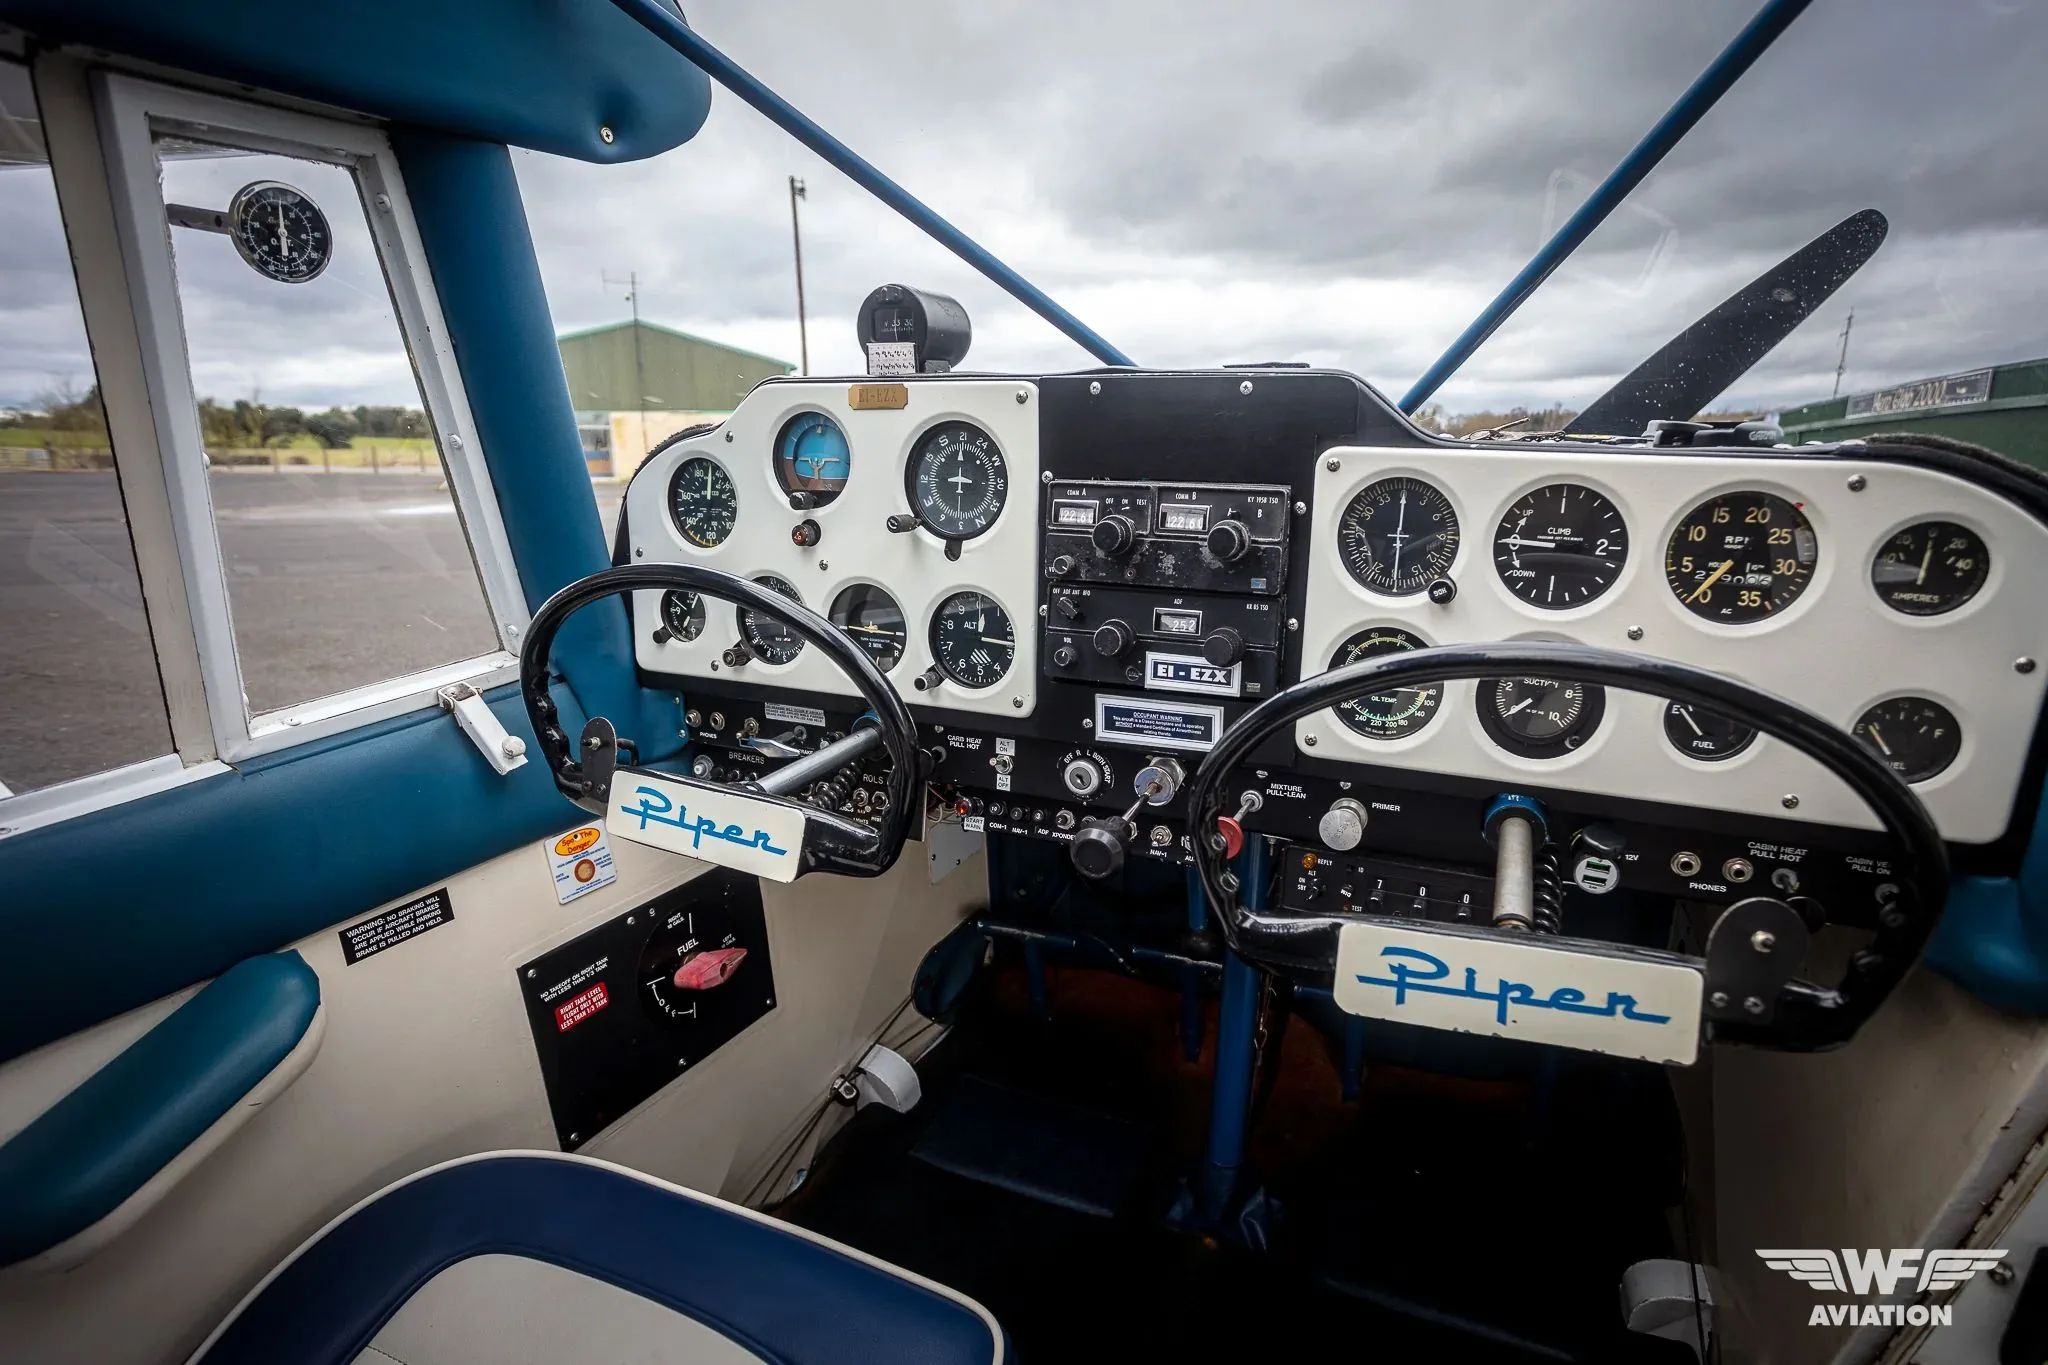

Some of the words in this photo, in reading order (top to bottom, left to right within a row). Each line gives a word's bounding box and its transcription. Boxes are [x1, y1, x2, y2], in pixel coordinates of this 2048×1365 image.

[938, 434, 949, 447] S
[959, 431, 968, 441] 21
[976, 437, 989, 450] 24
[1175, 492, 1189, 500] COMM
[1376, 493, 1391, 506] 33
[1361, 506, 1374, 521] 30
[1712, 507, 1730, 523] 15
[1744, 506, 1771, 524] 20
[1547, 527, 1571, 536] CLIMB
[1688, 525, 1706, 542] 10
[1767, 528, 1792, 544] 25
[1595, 538, 1609, 556] 2
[1949, 537, 1968, 549] 20
[1426, 550, 1440, 563] 12
[1371, 561, 1384, 573] 21
[1411, 563, 1424, 576] 15
[1681, 557, 1694, 573] 5
[1772, 558, 1797, 575] 30
[1955, 558, 1973, 570] 40
[1513, 570, 1536, 578] DOWN
[1737, 590, 1761, 607] 35
[1891, 591, 1940, 603] AMPERES
[958, 604, 965, 615] 9
[1720, 607, 1733, 615] AC
[947, 620, 954, 630] 8
[963, 621, 978, 630] ALT
[946, 641, 953, 651] 7
[959, 658, 966, 668] 6
[993, 662, 1001, 672] 4
[977, 665, 984, 676] 5
[1157, 663, 1174, 678] EI
[1190, 667, 1228, 683] EZX
[1505, 682, 1514, 691] 2
[1381, 696, 1398, 704] TEMP.
[1564, 689, 1574, 699] 8
[1671, 705, 1681, 714] E
[1133, 711, 1159, 720] OCCUPANT
[1160, 714, 1183, 722] WARNING
[1548, 711, 1560, 721] 10
[699, 731, 717, 739] PHONES
[947, 734, 965, 742] CARB
[1934, 728, 1944, 739] F
[949, 740, 965, 748] PULL
[1692, 740, 1715, 749] FUEL
[728, 751, 765, 765] BREAKERS
[1063, 752, 1074, 764] OFF
[1092, 751, 1106, 766] BOTH
[1102, 764, 1111, 784] START
[862, 773, 884, 785] ROLS
[1266, 788, 1307, 799] PULL-LEAN
[1270, 782, 1303, 793] MIXTURE
[1371, 802, 1401, 812] PRIMER
[621, 786, 788, 856] Piper
[989, 822, 1007, 830] COM-1
[1011, 827, 1028, 835] NAV-1
[1037, 828, 1050, 836] ADF
[1051, 831, 1076, 841] XPONDE
[562, 838, 575, 847] Spo
[580, 830, 593, 839] The
[567, 840, 591, 854] Danger
[1747, 841, 1778, 852] CABIN
[1780, 846, 1808, 856] HEAT
[1317, 858, 1333, 866] REPLY
[1750, 849, 1776, 859] PULL
[1779, 853, 1802, 863] HOT
[1845, 856, 1874, 866] CABIN
[1851, 864, 1873, 873] PULL
[1689, 882, 1727, 893] PHONES
[346, 918, 386, 938] WARNING:
[386, 913, 397, 921] NO
[398, 901, 425, 917] BRAKING
[425, 895, 440, 905] WILL
[667, 912, 681, 924] RIGHT
[352, 930, 376, 944] OCCUR
[377, 926, 383, 934] IF
[385, 913, 414, 931] AIRCRAFT
[415, 902, 440, 917] BRAKES
[354, 941, 368, 951] ARE
[369, 929, 395, 945] APPLIED
[396, 921, 415, 933] WHILE
[416, 908, 442, 924] PARKING
[355, 944, 378, 959] BRAKE
[387, 931, 411, 945] PULLED
[412, 924, 425, 934] AND
[722, 933, 733, 943] LEFT
[677, 937, 699, 956] FUEL
[540, 991, 549, 999] NO
[549, 977, 571, 993] TAKEOFF
[572, 973, 580, 981] ON
[580, 963, 595, 975] RIGHT
[595, 956, 608, 966] TANK
[543, 992, 557, 1002] WITH
[557, 983, 572, 995] LESS
[572, 975, 586, 986] THAN
[595, 963, 608, 973] TANK
[1355, 946, 1672, 1026] Piper
[560, 1002, 575, 1015] RIGHT
[574, 995, 587, 1006] TANK
[587, 986, 602, 998] LEVEL
[563, 1007, 580, 1021] FLIGHT
[579, 1000, 592, 1011] ONLY
[592, 992, 604, 1003] WITH
[560, 1019, 574, 1030] LESS
[573, 1011, 587, 1023] THAN
[587, 1006, 595, 1014] 1/3
[595, 997, 608, 1009] TANK
